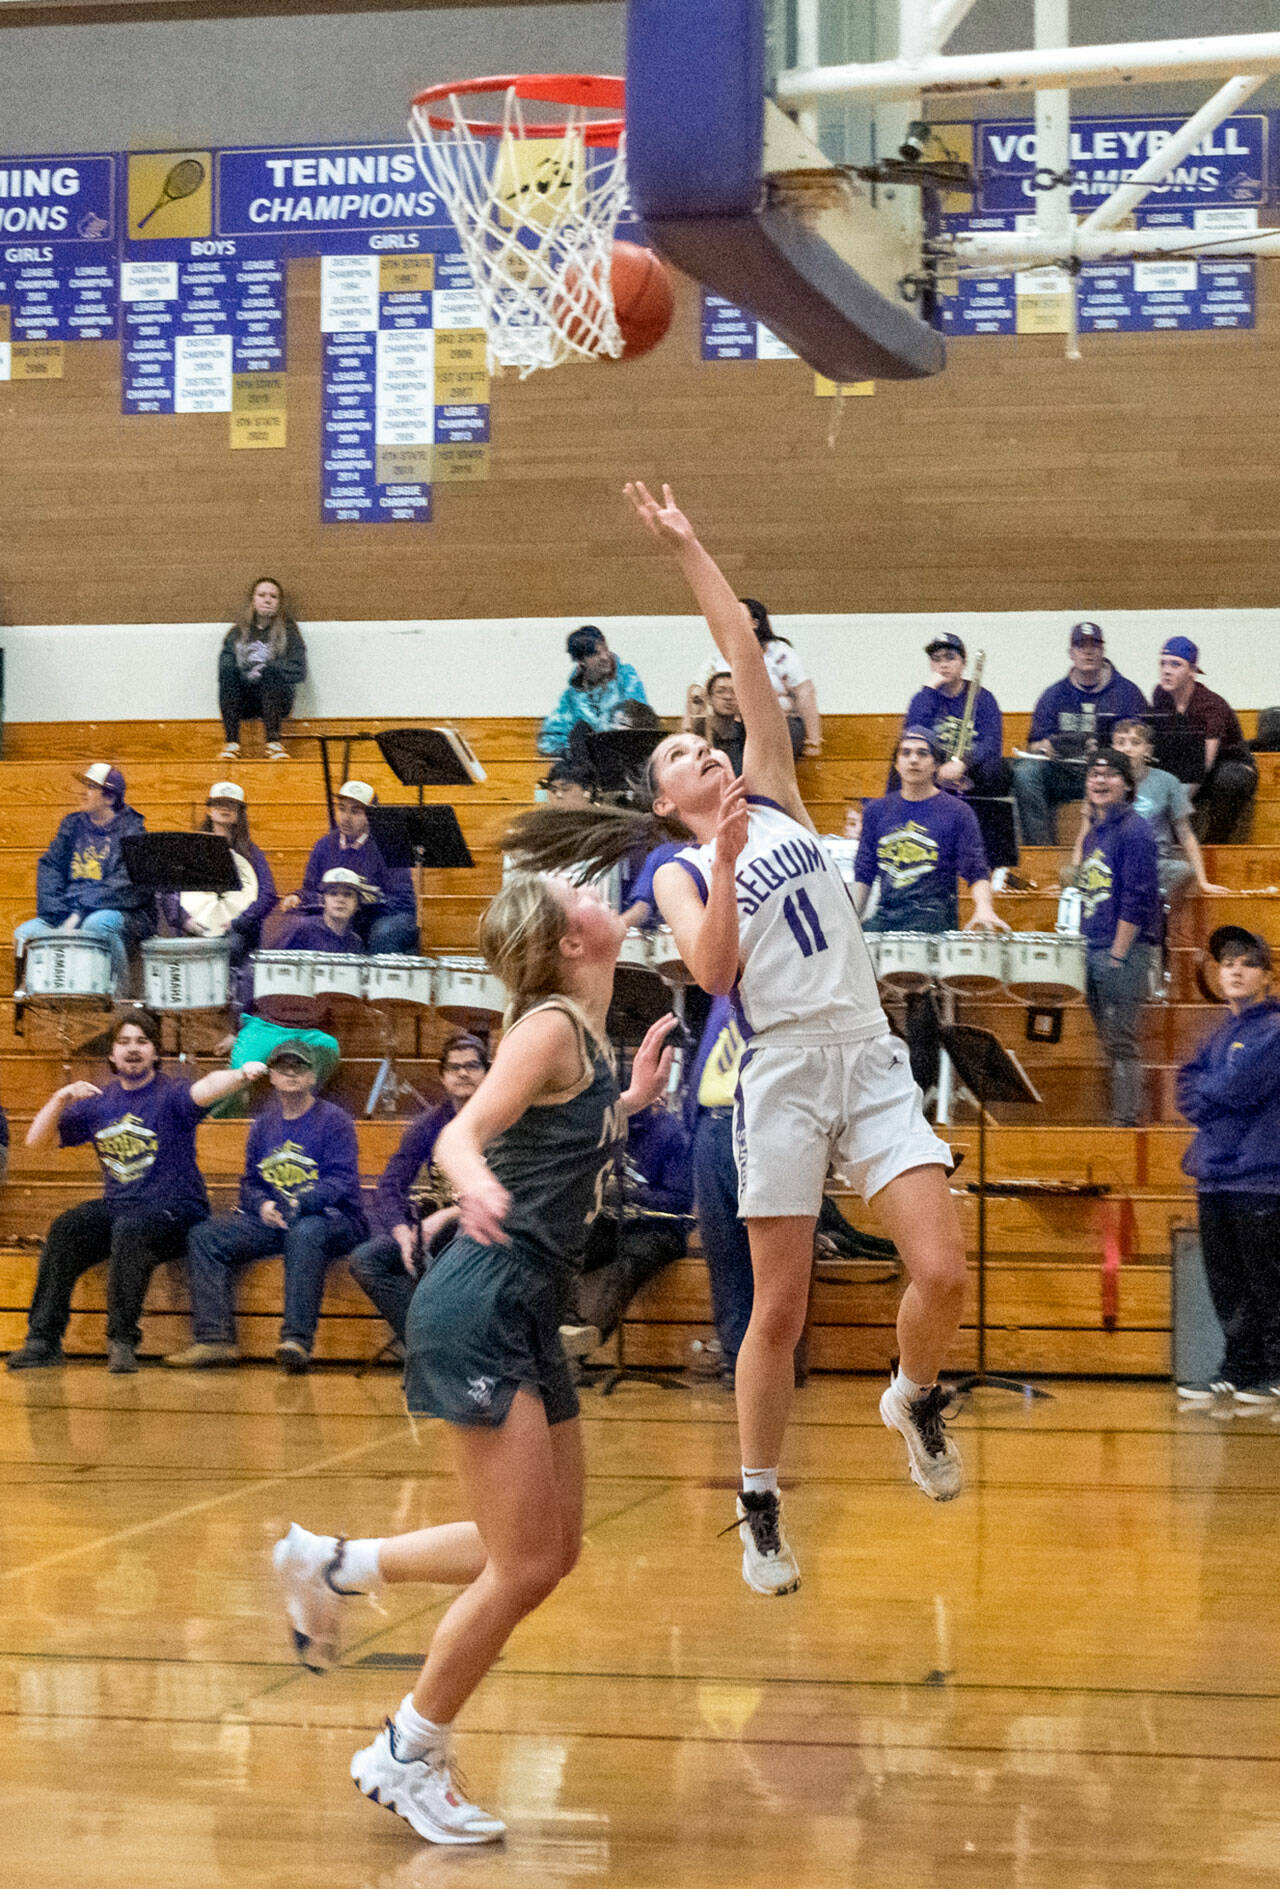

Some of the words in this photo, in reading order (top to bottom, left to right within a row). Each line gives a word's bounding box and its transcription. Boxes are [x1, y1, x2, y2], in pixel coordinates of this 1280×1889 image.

[988, 128, 1250, 162] VOLEYBLL
[266, 154, 416, 188] TENNIS
[249, 191, 437, 223] CHAMPIONS
[5, 246, 54, 263] GIRLS
[190, 240, 236, 256] BOYS
[369, 232, 421, 250] GIRLS
[736, 838, 827, 916] SEQUIM
[783, 887, 829, 958] 11
[53, 947, 66, 989] YAMAHA
[169, 962, 183, 1004] YAMAHA
